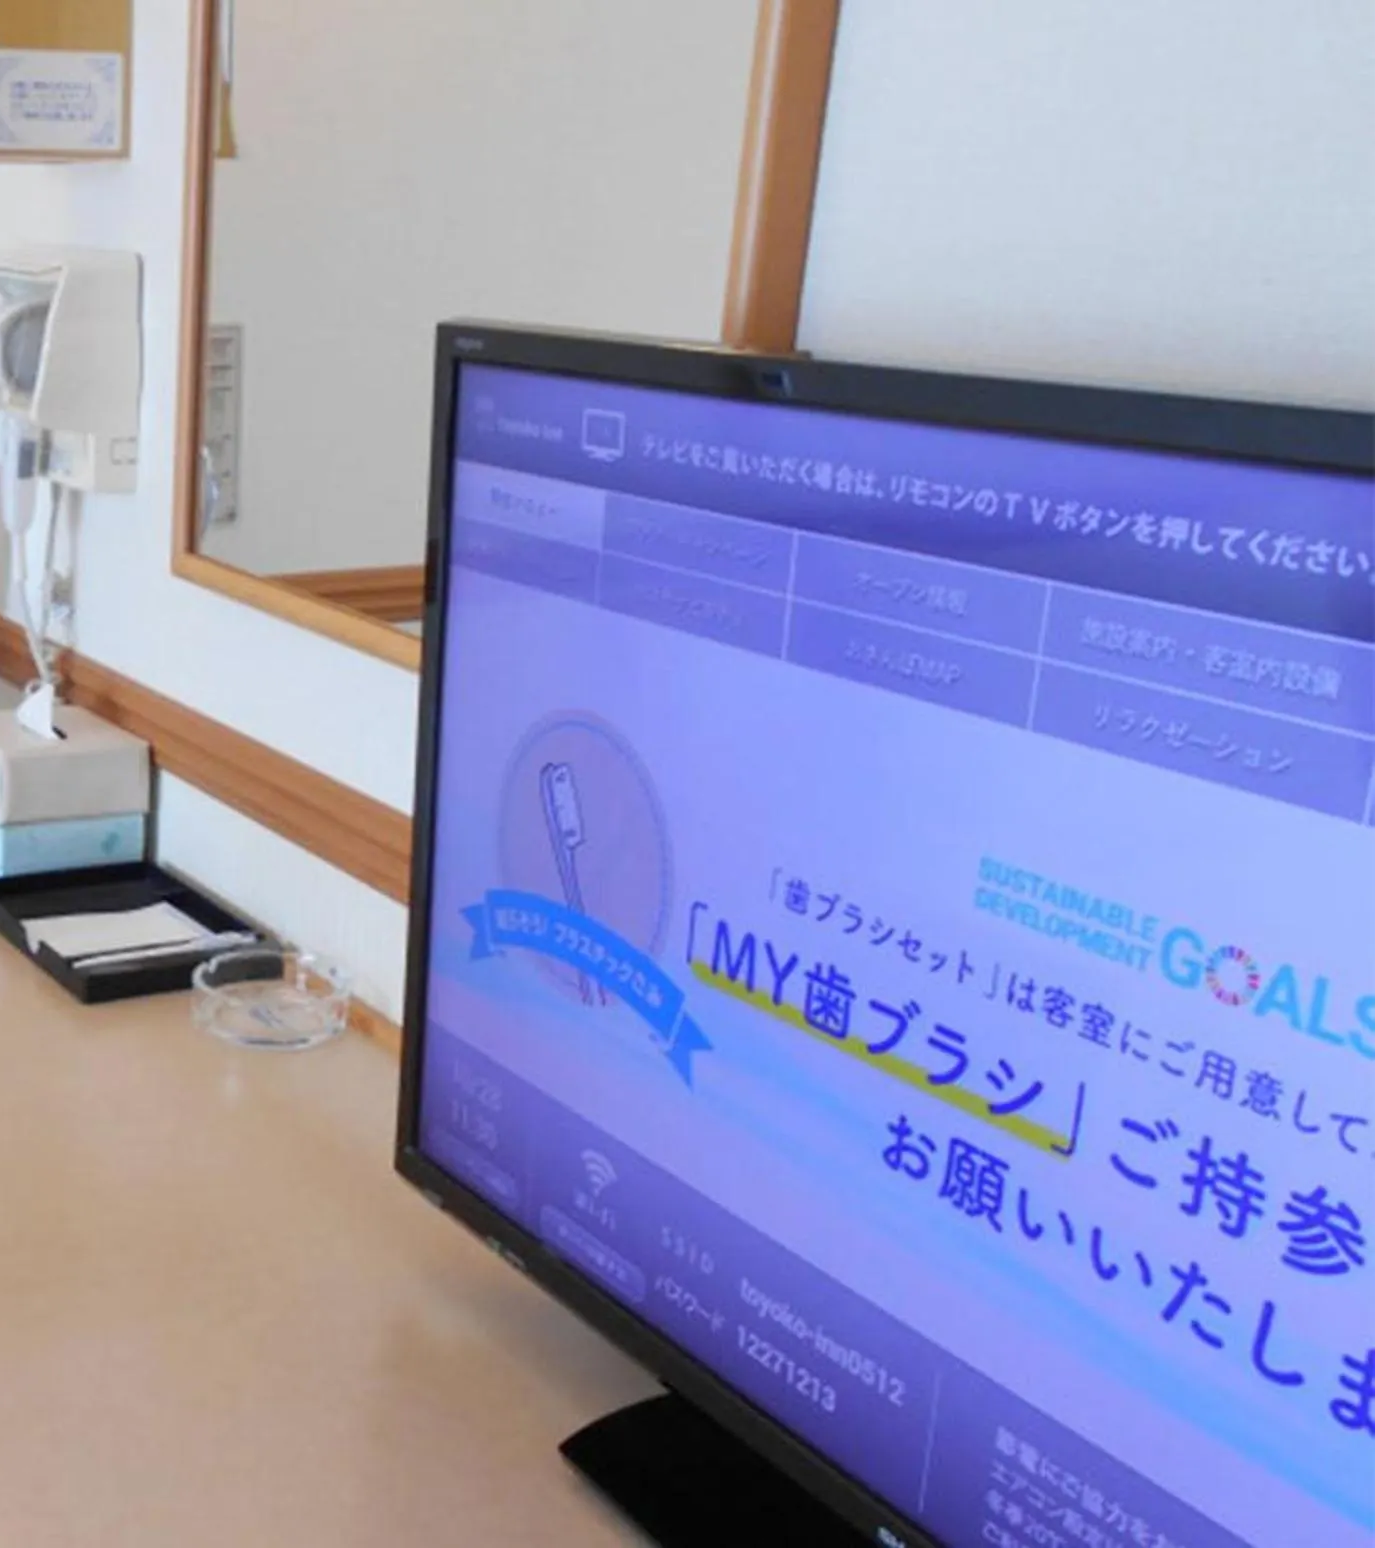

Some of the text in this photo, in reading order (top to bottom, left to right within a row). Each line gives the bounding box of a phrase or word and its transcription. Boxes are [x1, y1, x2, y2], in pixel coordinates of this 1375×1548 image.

[974, 886, 1154, 974] DEVELOPMENT
[978, 856, 1160, 943] SUSTAINABLE
[770, 866, 1375, 1168] 「歯ブラシセット」は客室にご用意して
